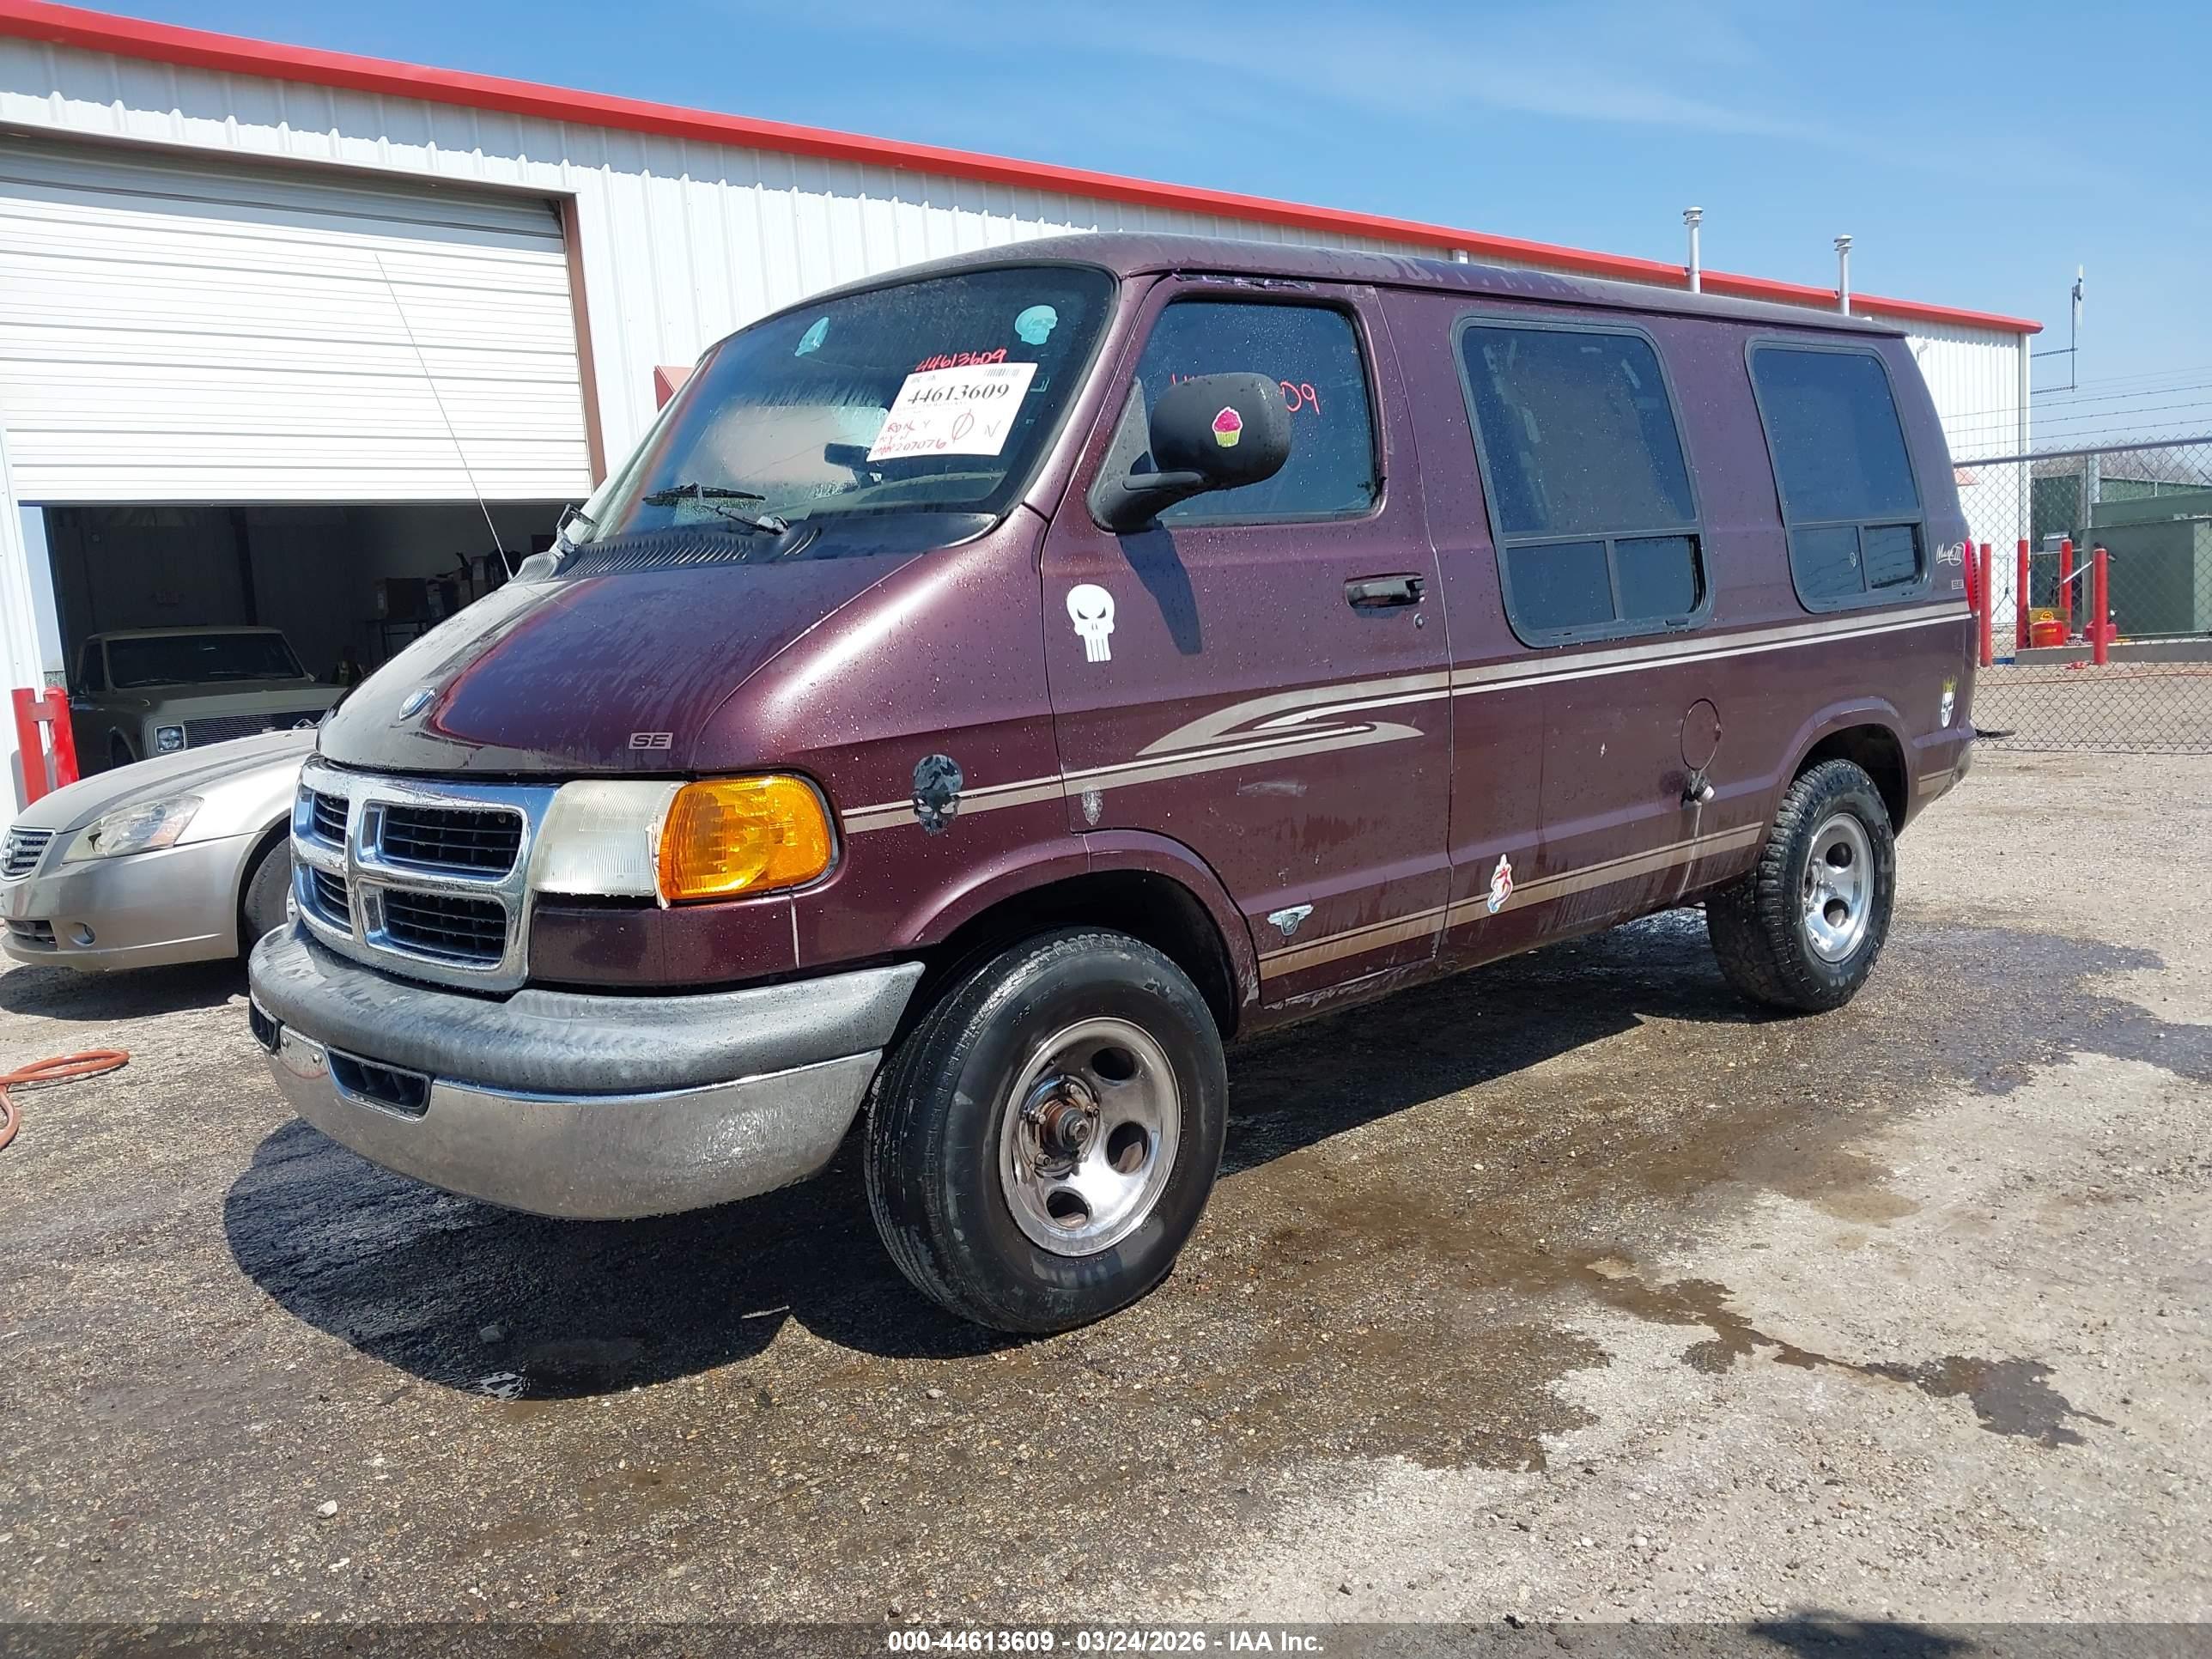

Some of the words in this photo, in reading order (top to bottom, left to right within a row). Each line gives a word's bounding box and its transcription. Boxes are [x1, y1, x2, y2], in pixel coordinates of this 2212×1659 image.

[915, 348, 1007, 372] 44613609
[907, 383, 1010, 405] 44613609
[631, 733, 671, 748] SE
